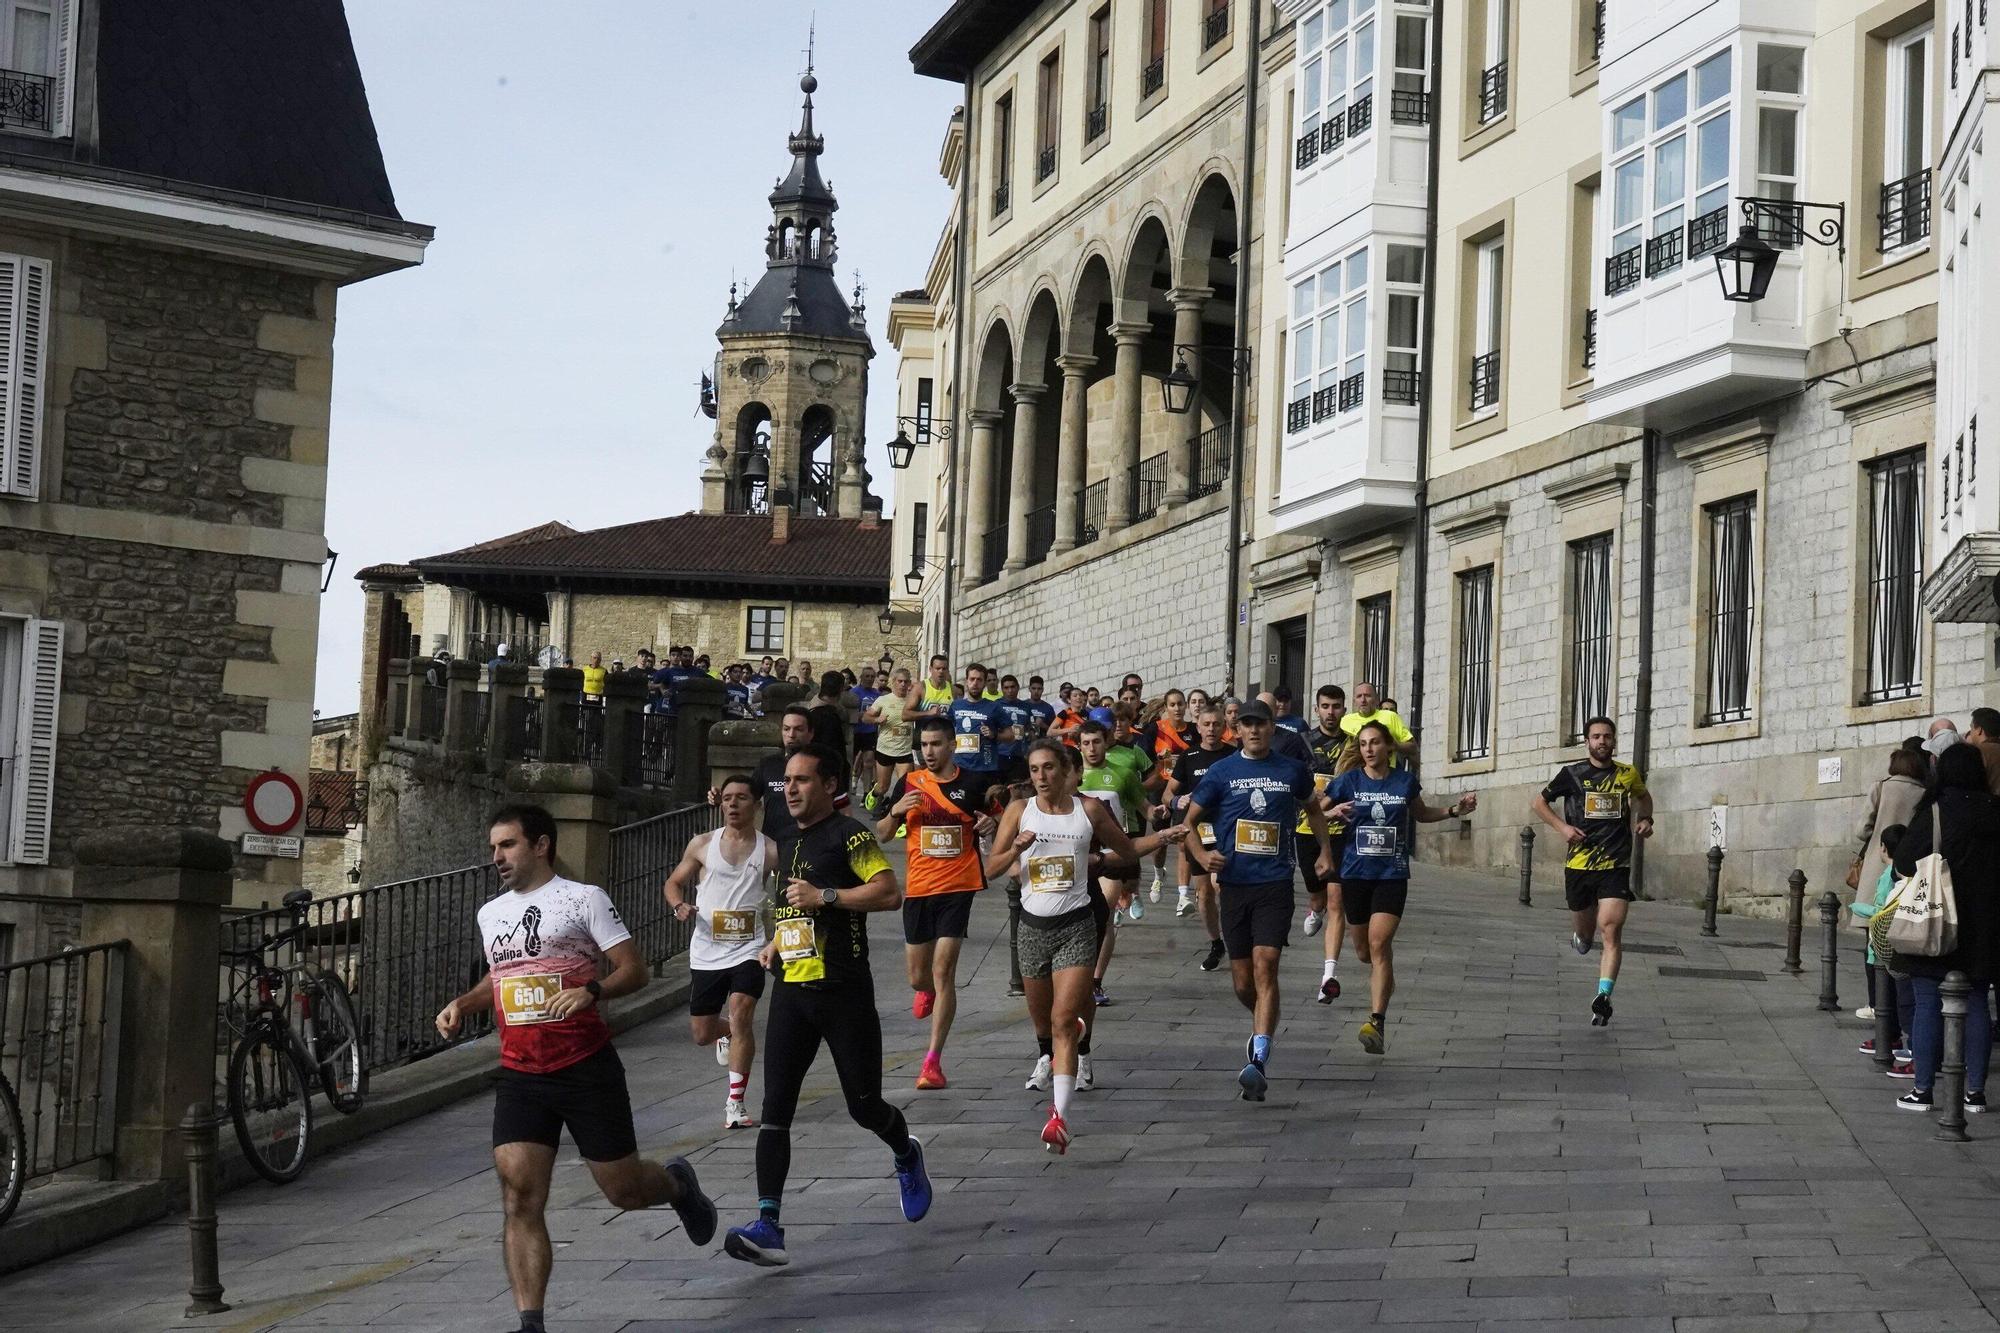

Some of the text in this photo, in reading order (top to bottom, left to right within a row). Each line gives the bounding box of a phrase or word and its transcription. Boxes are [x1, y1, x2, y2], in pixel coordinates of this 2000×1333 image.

[931, 833, 953, 846] 463
[1250, 829, 1267, 842] 113
[1366, 833, 1385, 845] 755
[1039, 863, 1064, 879] 395
[724, 917, 746, 930] 294
[492, 948, 523, 964] Galipa
[514, 986, 545, 1007] 650
